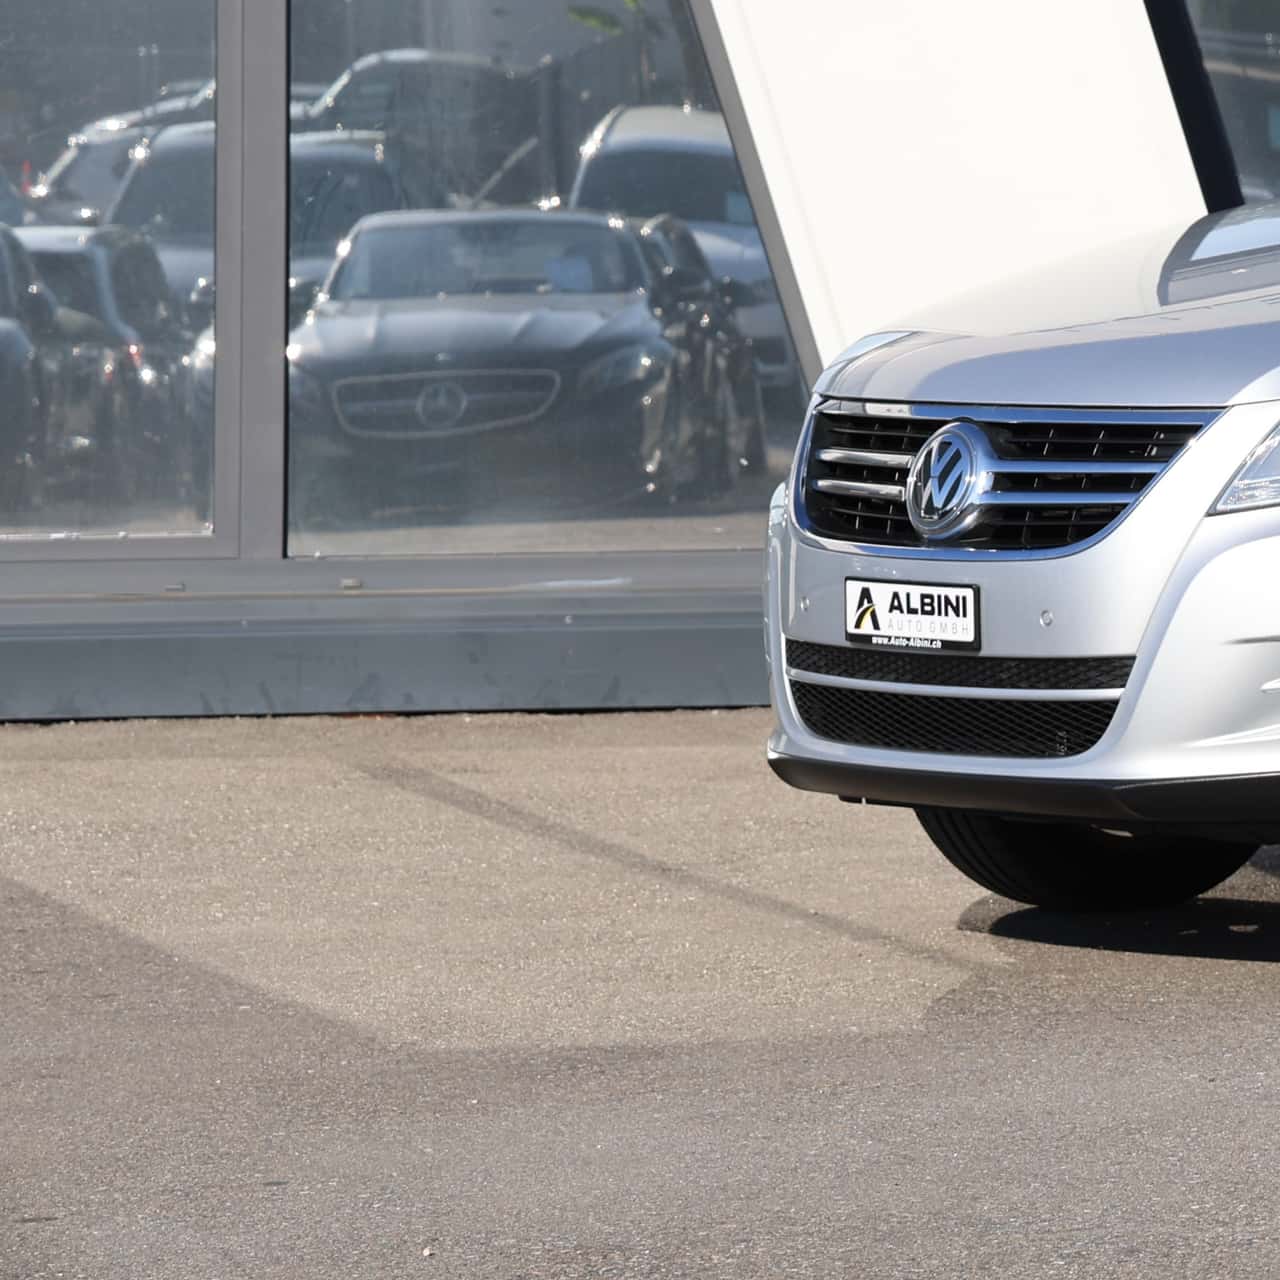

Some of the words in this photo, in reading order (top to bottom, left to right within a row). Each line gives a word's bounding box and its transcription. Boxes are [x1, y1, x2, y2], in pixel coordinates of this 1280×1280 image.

[888, 591, 967, 619] ALBINI
[888, 619, 924, 633] AUTO
[929, 621, 969, 636] GMBH
[871, 635, 943, 649] www.Auto-Albini.ch
